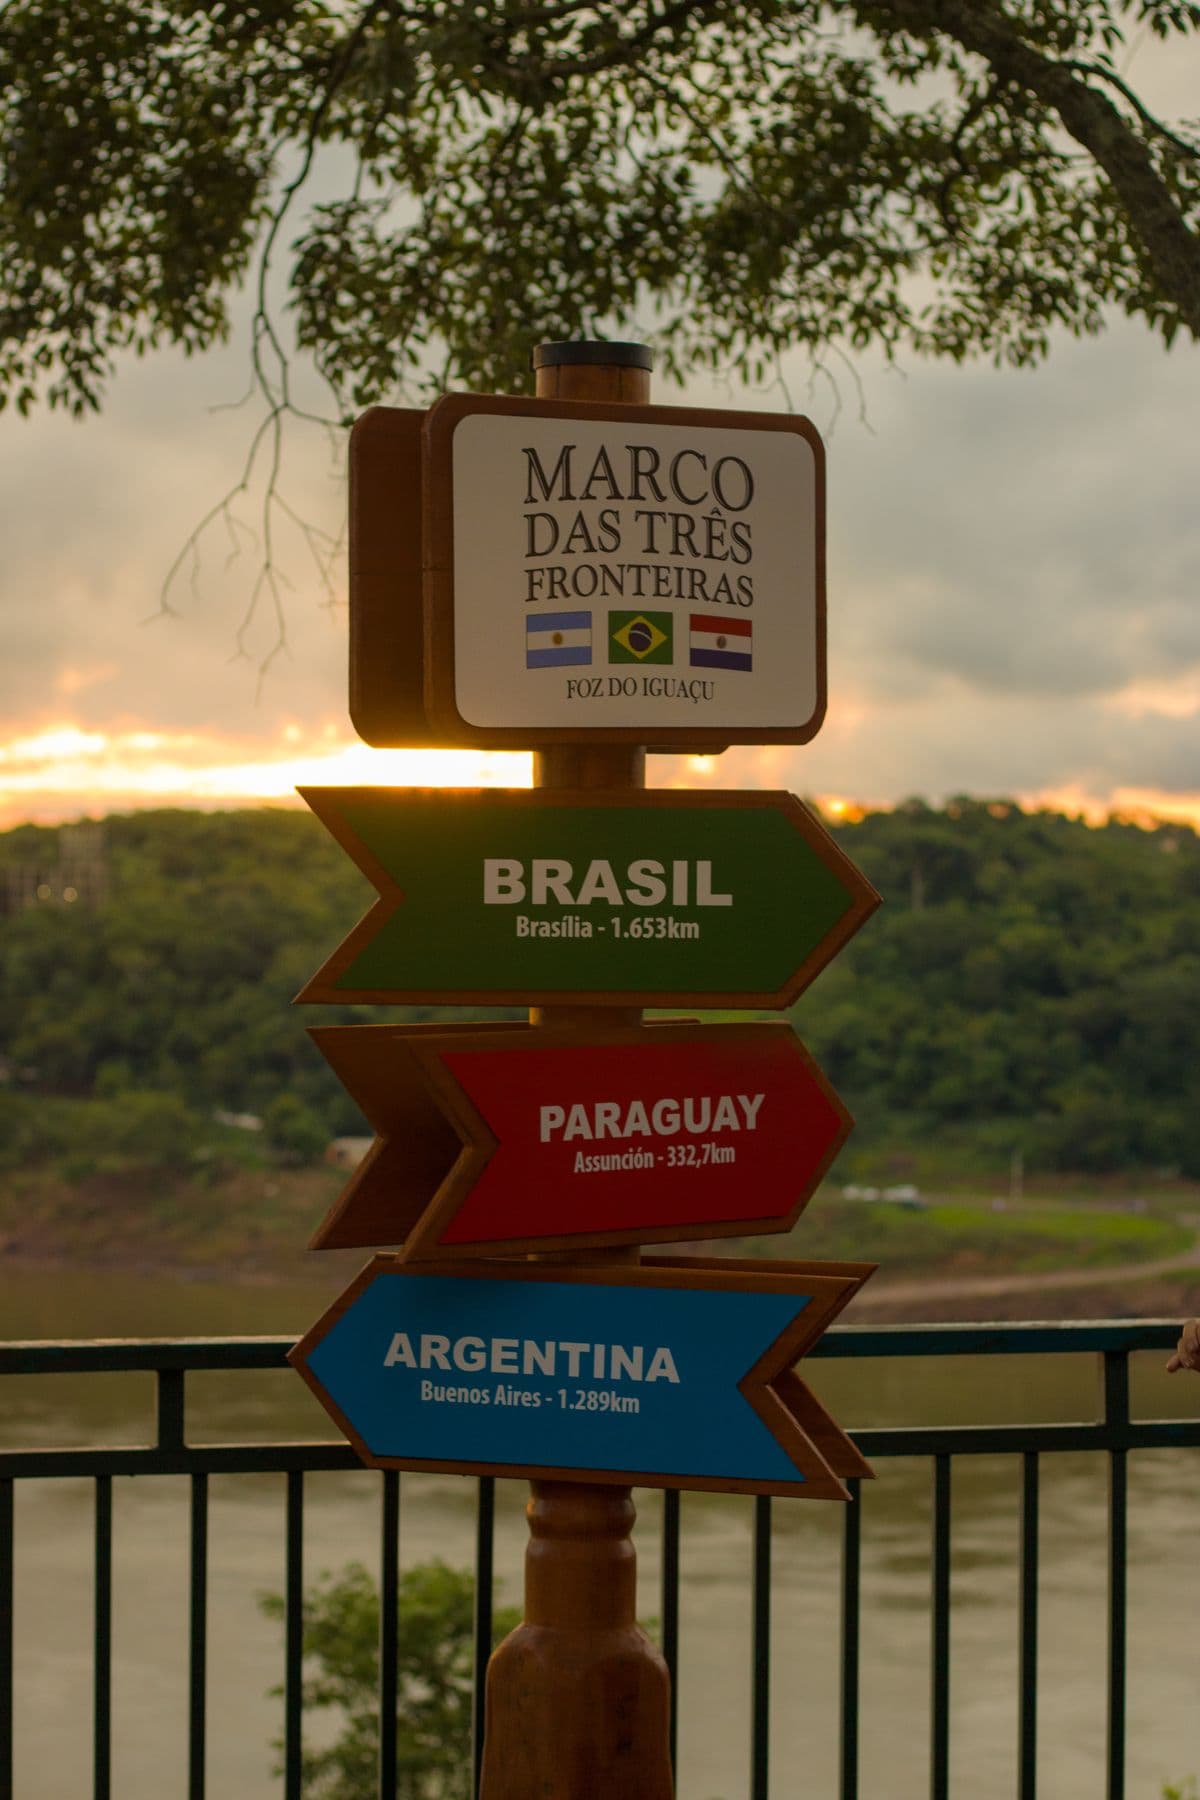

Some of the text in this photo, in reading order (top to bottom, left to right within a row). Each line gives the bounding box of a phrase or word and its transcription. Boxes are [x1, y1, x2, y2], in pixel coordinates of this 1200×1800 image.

[522, 444, 755, 512] MARCO
[523, 507, 753, 565] DAS TRÊS
[524, 563, 754, 608] FRONTEIRAS
[567, 677, 714, 704] FOZ DO IGUAÇU
[483, 858, 734, 907] BRASIL
[516, 915, 593, 938] Brasília
[610, 916, 700, 940] 1.653km
[540, 1093, 766, 1143] PARAGUAY
[574, 1147, 654, 1173] Assunción
[667, 1142, 736, 1168] 332,7km
[383, 1332, 680, 1384] ARGENTINA
[421, 1380, 490, 1405] Buenos
[493, 1385, 542, 1408] Aires
[558, 1389, 640, 1414] 1.289km
